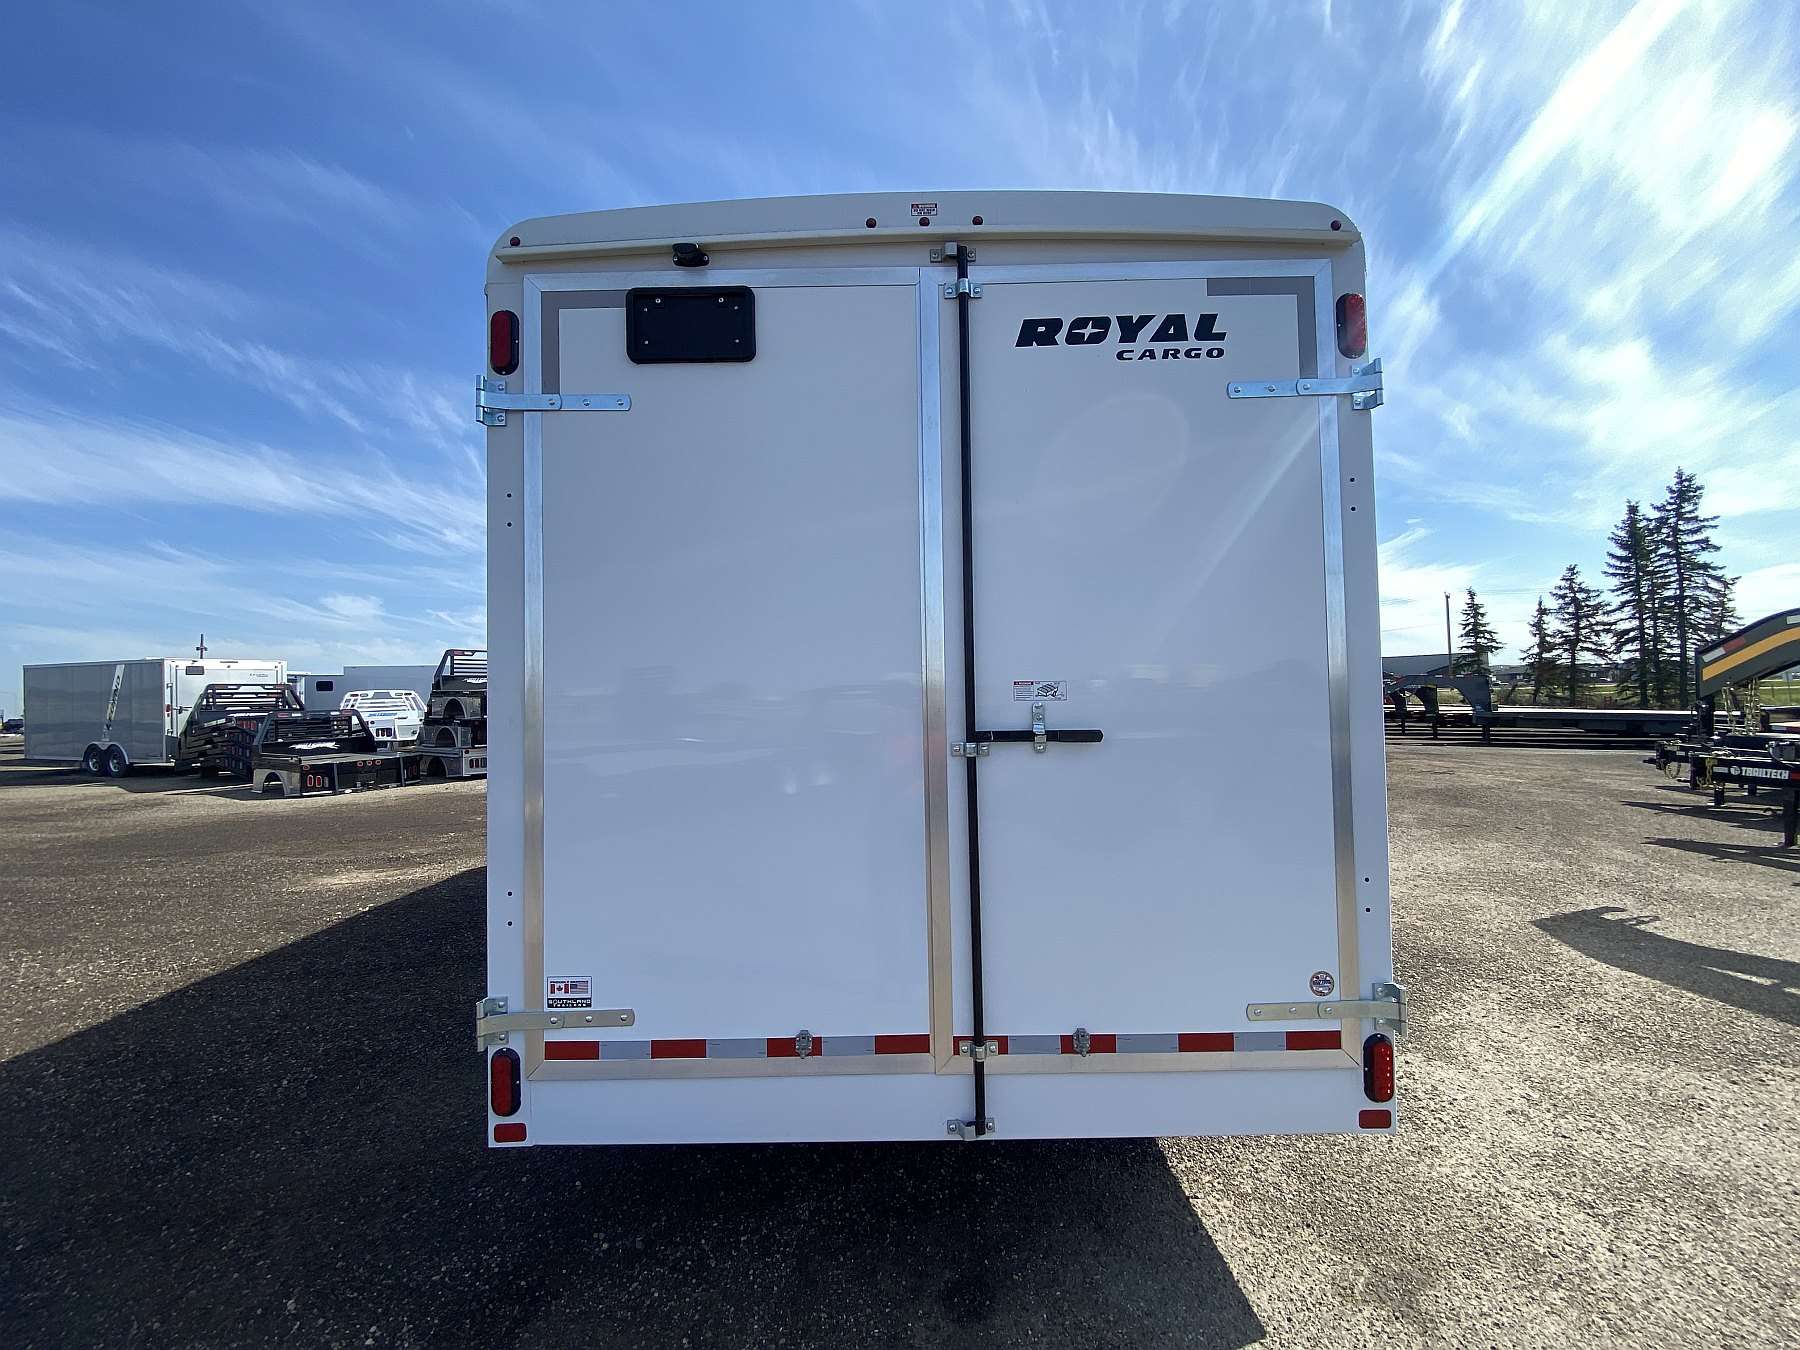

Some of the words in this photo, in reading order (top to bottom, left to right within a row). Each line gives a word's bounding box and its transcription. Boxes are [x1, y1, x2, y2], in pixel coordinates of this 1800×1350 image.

[1015, 313, 1227, 348] ROYAL
[1116, 347, 1225, 361] CARGO
[1741, 767, 1789, 779] TRAILTECH
